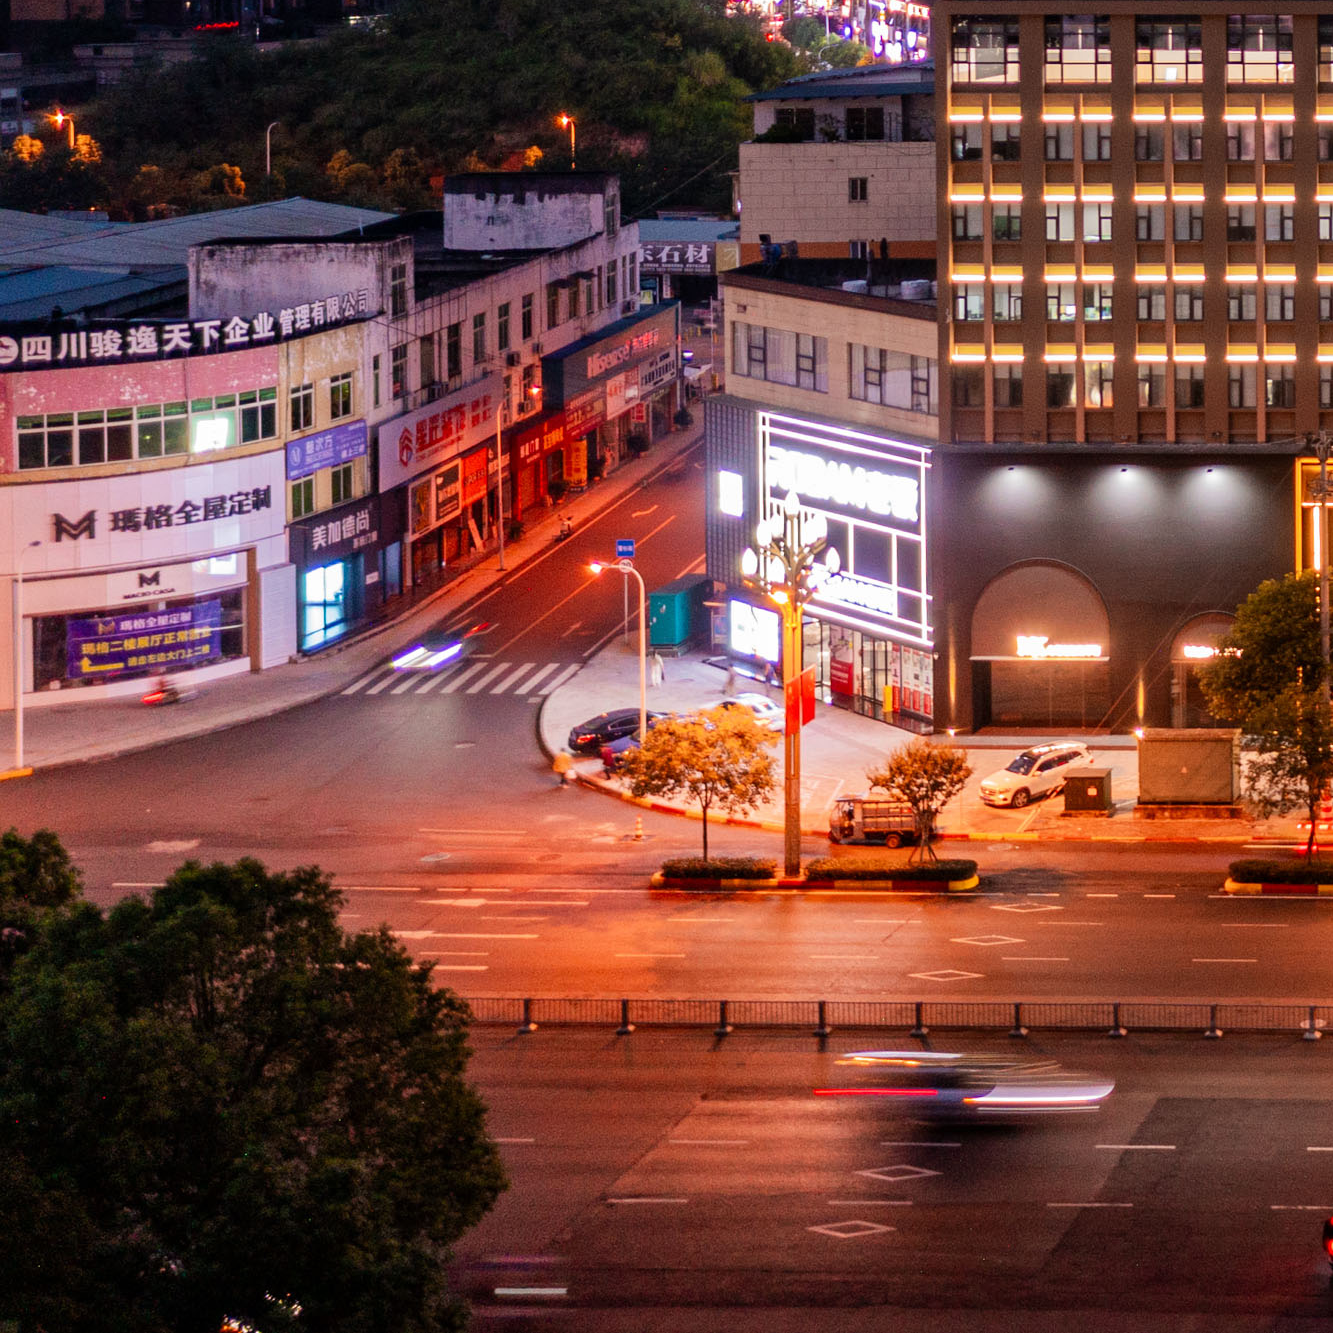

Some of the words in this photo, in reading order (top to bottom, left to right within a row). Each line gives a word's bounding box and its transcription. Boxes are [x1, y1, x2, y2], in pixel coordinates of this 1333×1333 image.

[22, 289, 369, 362] 四川骏逸天下企业管理有限公司
[110, 484, 272, 533] 瑪格全屋定制
